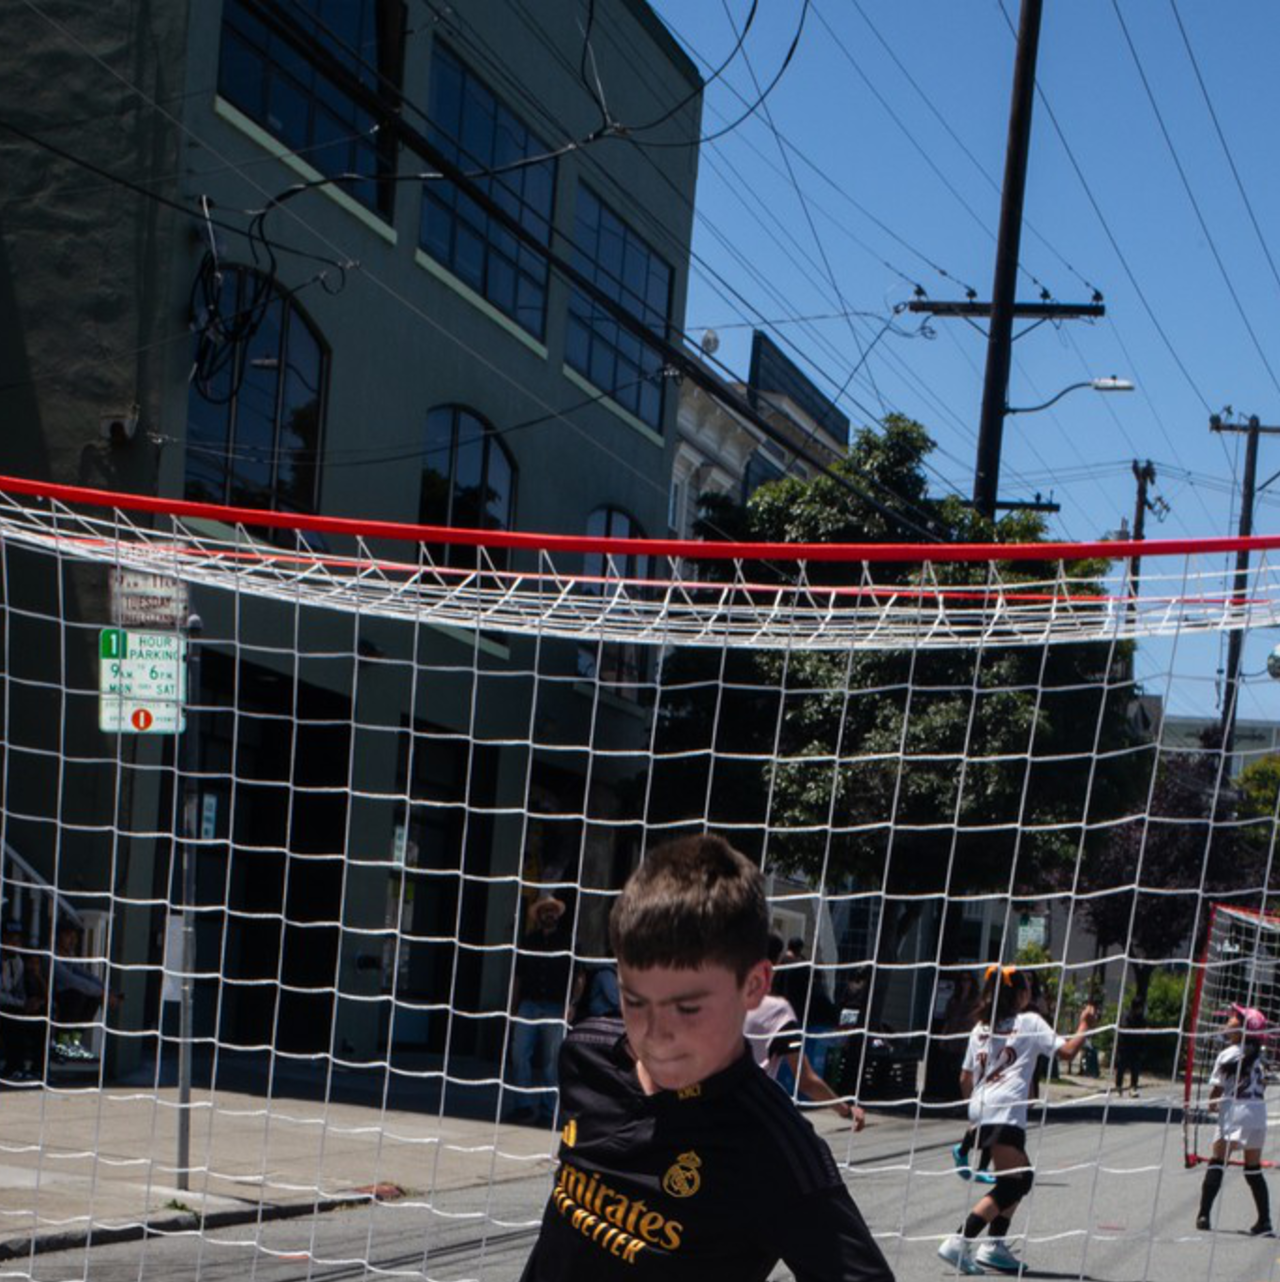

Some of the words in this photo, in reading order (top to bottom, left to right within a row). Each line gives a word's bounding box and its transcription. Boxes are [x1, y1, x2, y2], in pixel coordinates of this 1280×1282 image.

[110, 633, 118, 656] 1
[138, 636, 172, 648] HOUR
[156, 684, 175, 696] SAT
[560, 1164, 684, 1250] mirates
